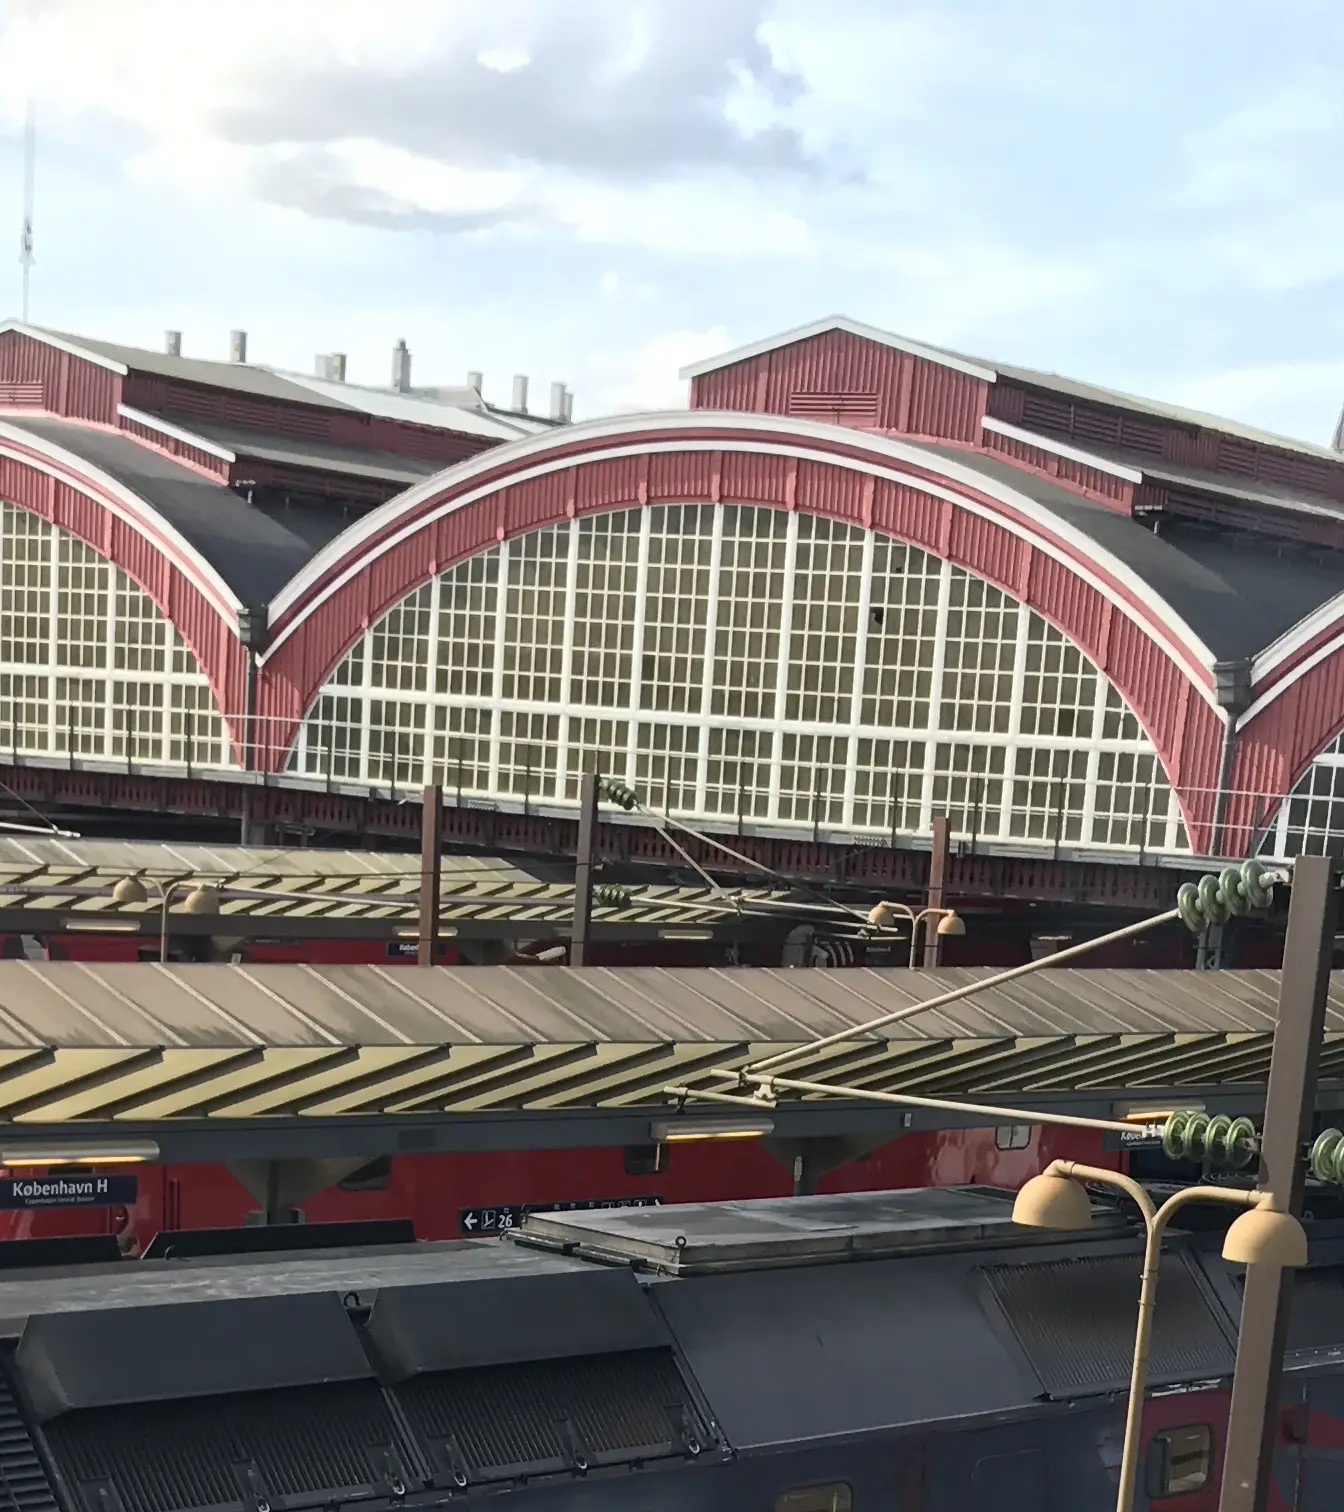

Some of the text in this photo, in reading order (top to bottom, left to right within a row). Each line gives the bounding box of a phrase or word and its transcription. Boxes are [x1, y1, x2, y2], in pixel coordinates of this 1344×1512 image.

[12, 1178, 108, 1197] København H
[498, 1214, 513, 1228] 26
